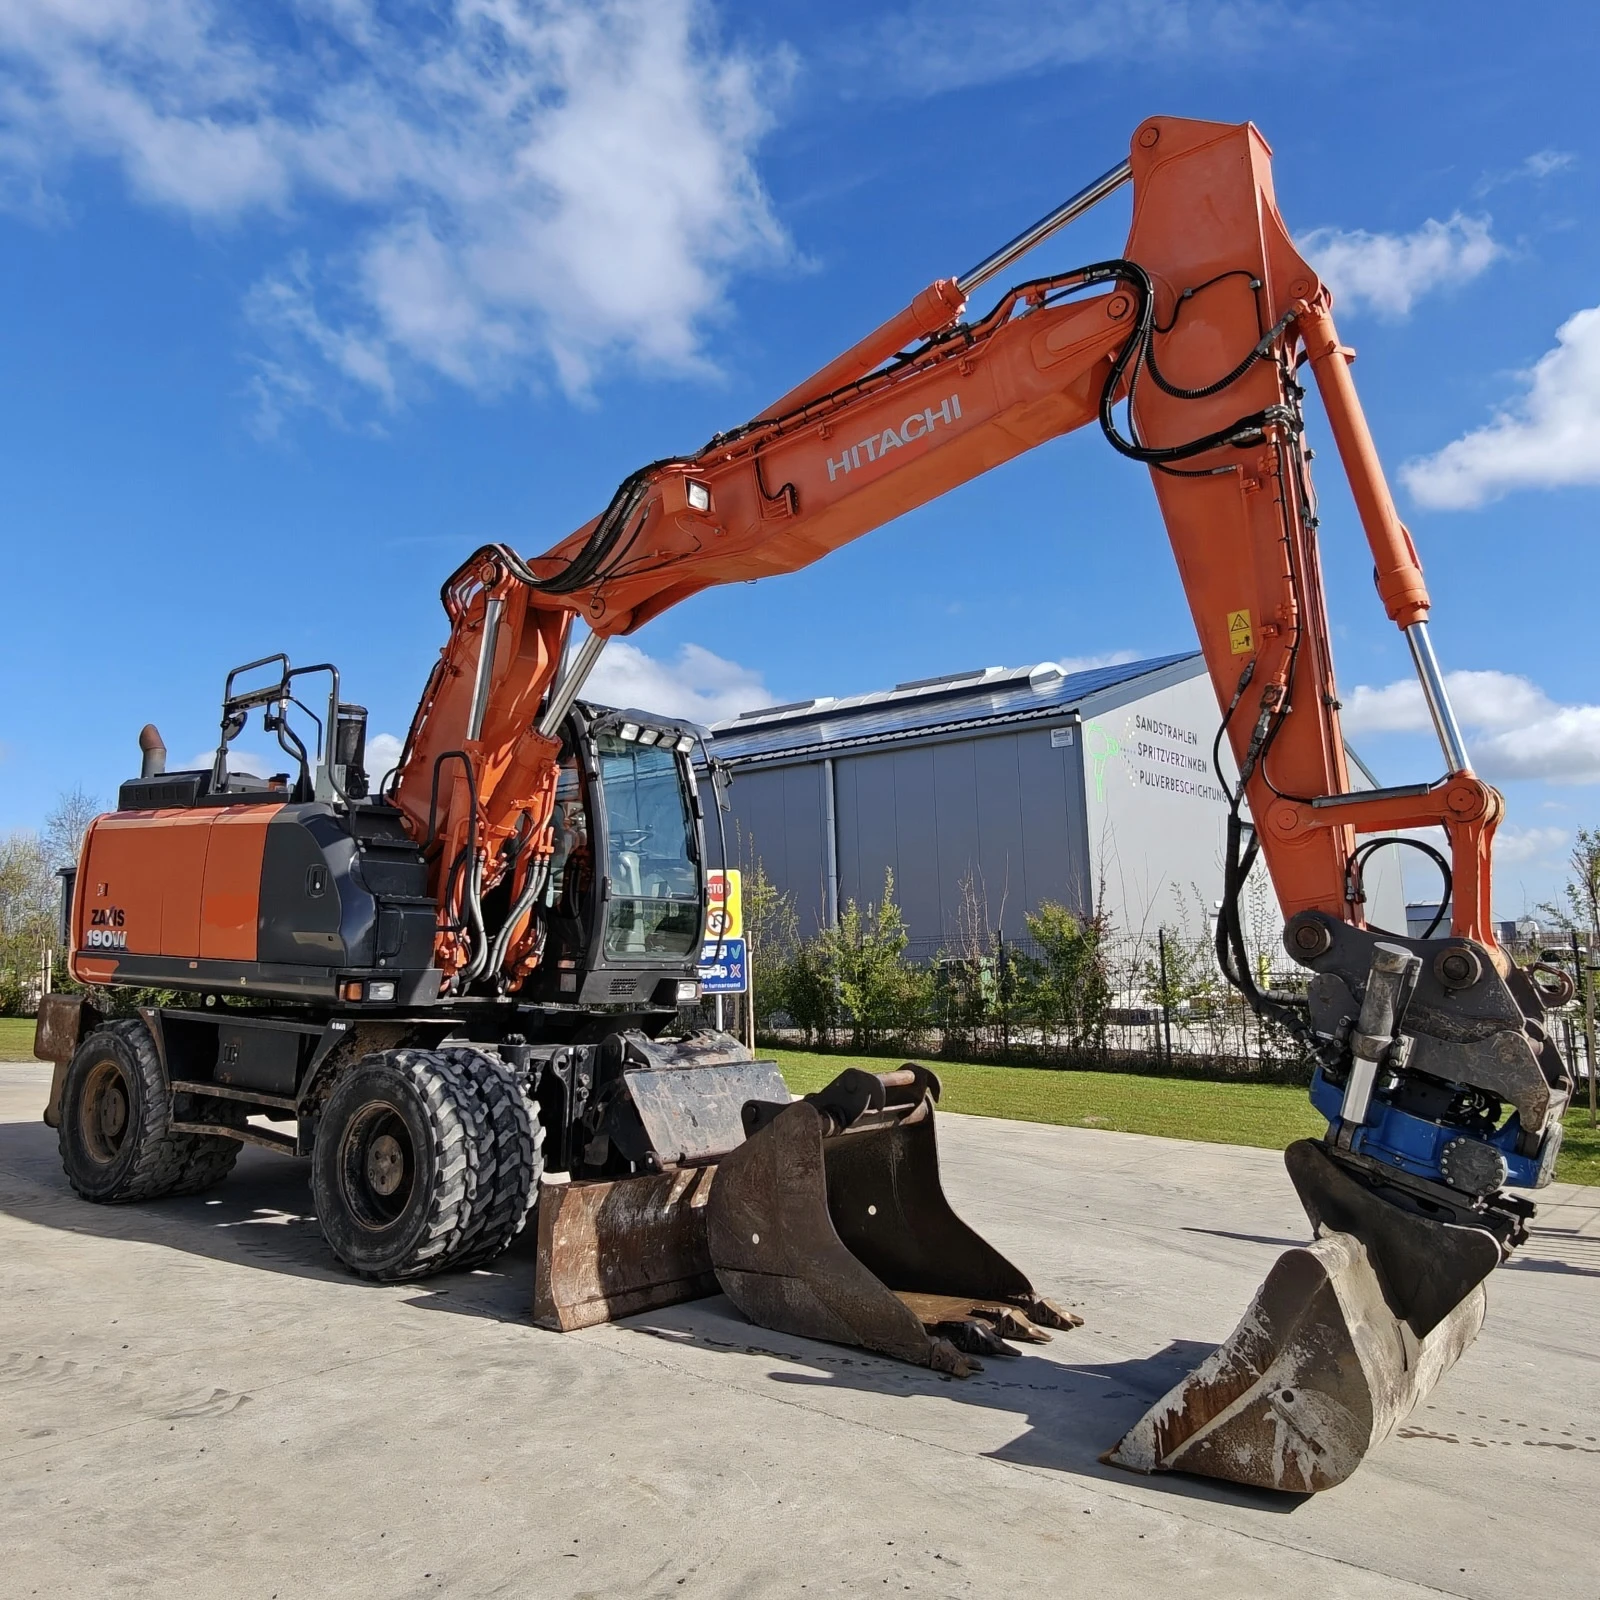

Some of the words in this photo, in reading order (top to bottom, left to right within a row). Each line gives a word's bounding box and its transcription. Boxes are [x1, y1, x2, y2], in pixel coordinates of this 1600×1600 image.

[826, 393, 962, 482] HITACHI
[1135, 714, 1198, 746] SANDSTRAHLEN
[1137, 742, 1207, 773] SPRITZVERZINKEN
[1139, 770, 1228, 803] PULVERBESCHICHTUNG
[91, 907, 125, 927] ZAXIS
[86, 929, 128, 948] 190W
